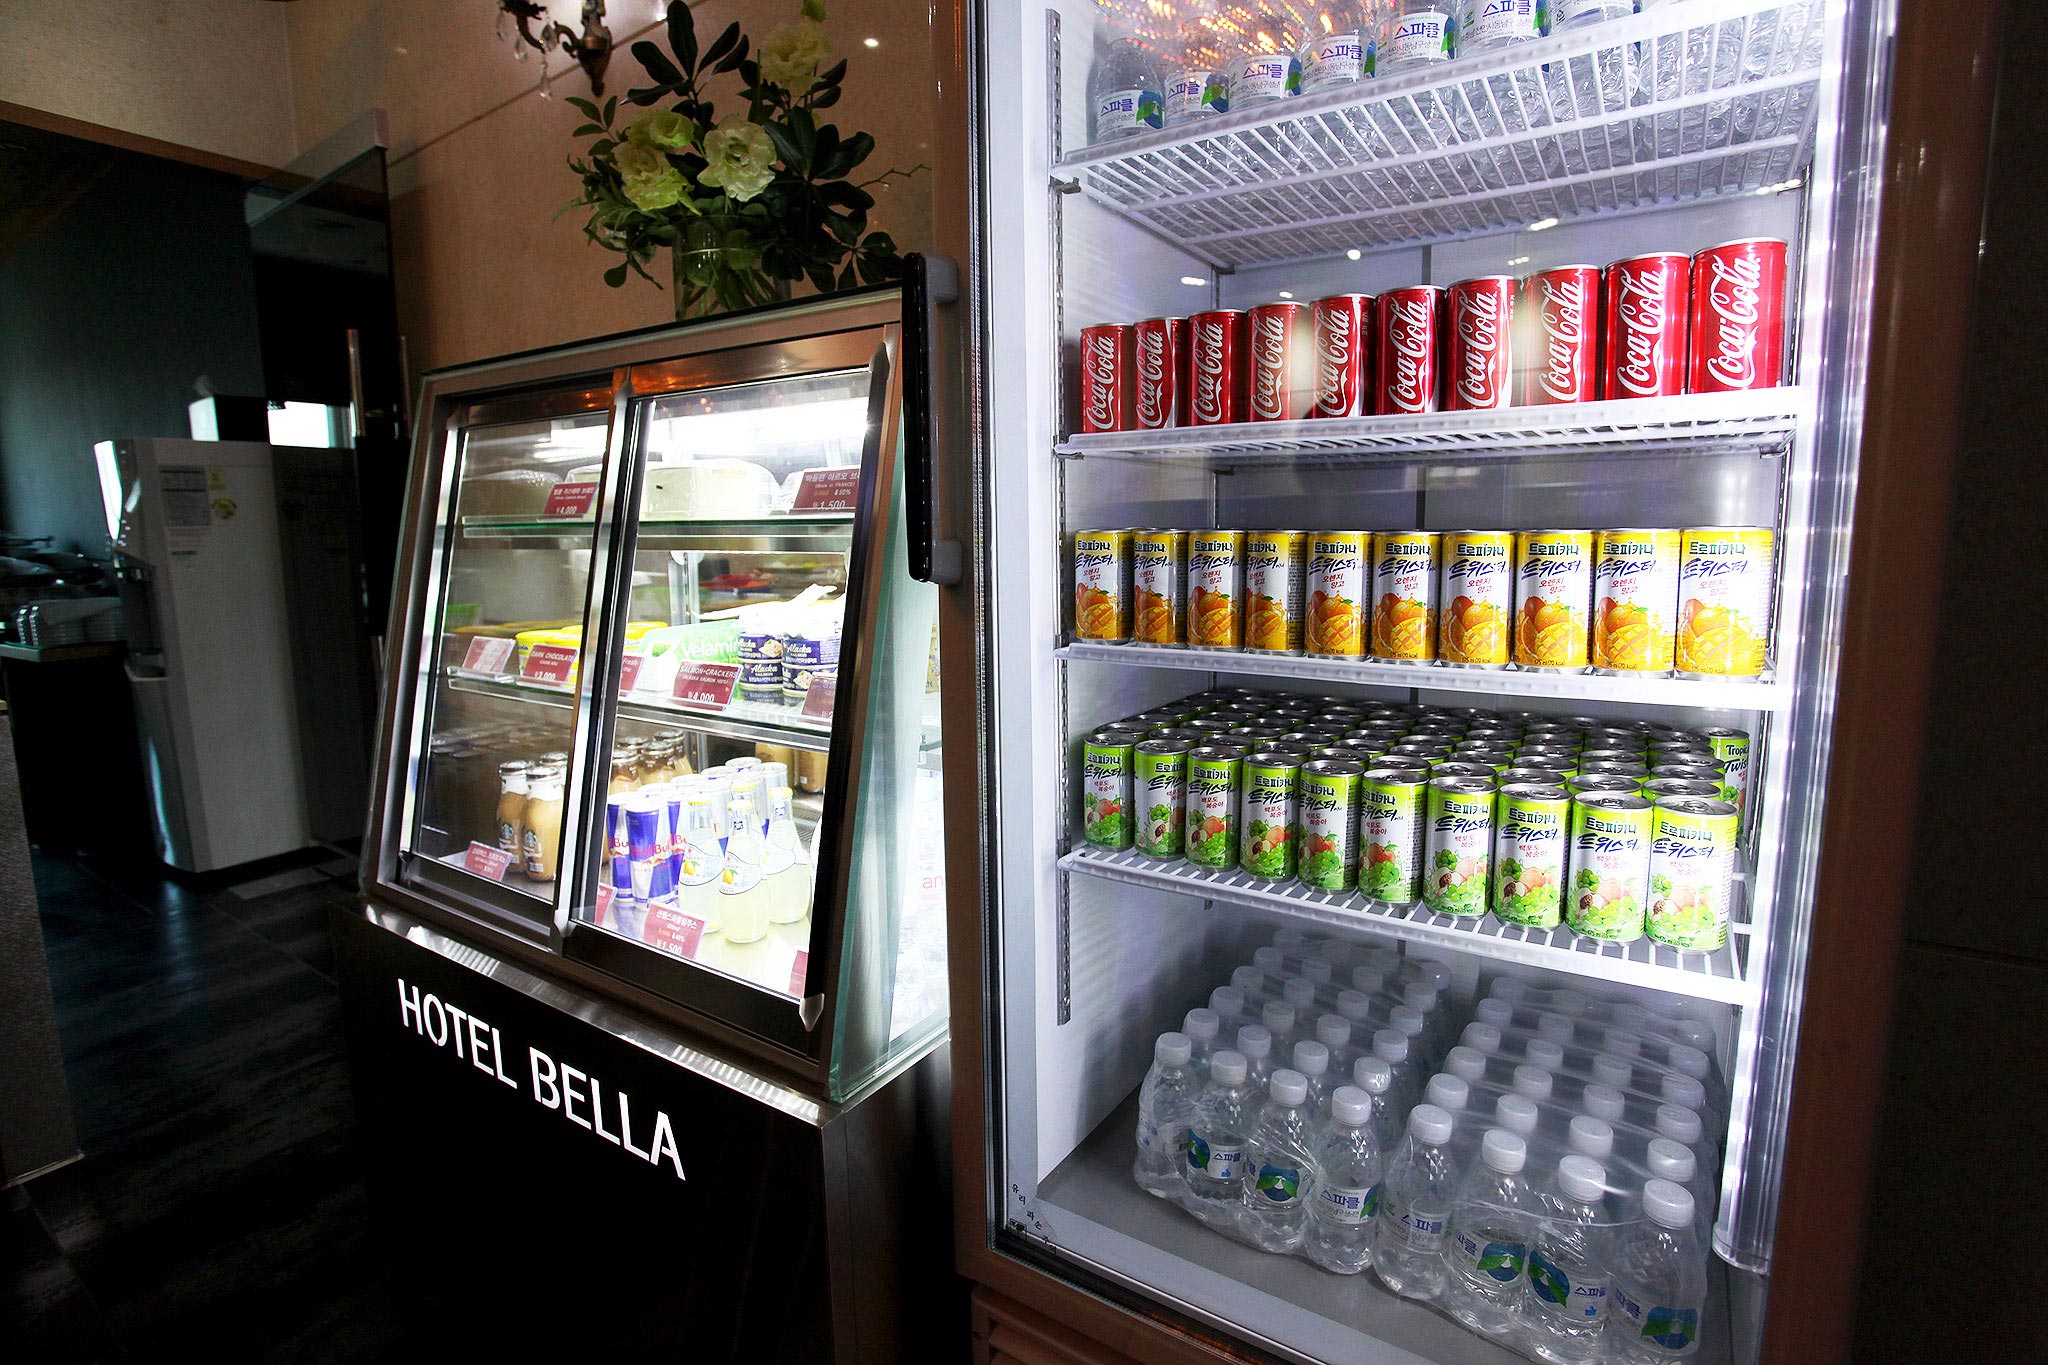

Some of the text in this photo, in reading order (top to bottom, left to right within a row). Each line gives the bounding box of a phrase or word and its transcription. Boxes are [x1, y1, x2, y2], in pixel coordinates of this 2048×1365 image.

[1482, 0, 1532, 18] 스파클
[1394, 22, 1440, 39] 스파클
[1321, 44, 1364, 60] 스파클
[1243, 63, 1284, 79] 스파클
[1168, 81, 1200, 99] 스파클
[1100, 98, 1134, 116] 스파클
[1078, 540, 1110, 550] 트로피카나
[1194, 541, 1232, 552] 트로피카나
[1314, 542, 1356, 554] 트로피카나
[1385, 542, 1431, 555] 트로피카나
[1457, 544, 1504, 556] 트로피카나
[1529, 542, 1579, 556] 트로피카나
[1602, 541, 1654, 555] 트로피카나
[1689, 541, 1746, 555] 트로피카나
[1076, 552, 1112, 568] 트위스터
[1190, 554, 1234, 572] 트위스터
[1309, 556, 1358, 575] 트위스터
[1378, 557, 1432, 577] 트위스터
[1202, 570, 1220, 578] 오렌지
[1250, 571, 1264, 580] 오렌지
[1449, 559, 1506, 580] 트위스터
[1521, 558, 1581, 580] 트위스터
[1597, 558, 1656, 580] 트위스터
[1682, 558, 1748, 580] 트위스터
[1322, 574, 1344, 582] 오렌지
[1394, 576, 1417, 585] 오렌지
[1467, 578, 1490, 587] 오렌지
[1539, 578, 1564, 588] 오렌지
[1611, 578, 1636, 588] 오렌지
[1700, 579, 1726, 589] 오렌지
[1478, 586, 1492, 594] 망고
[1550, 586, 1565, 594] 망고
[1622, 586, 1637, 595] 망고
[1710, 588, 1728, 597] 망고
[787, 644, 812, 654] Alaska
[751, 664, 778, 673] Alaska
[1088, 752, 1120, 764] 트로피카나
[1084, 764, 1122, 779] 트위스터
[1194, 766, 1230, 779] 트로피카나
[1188, 780, 1232, 795] 트위스터
[1254, 775, 1294, 787] 트로피카나
[1248, 788, 1296, 804] 트위스터
[1509, 808, 1557, 824] 트로피카나
[1435, 816, 1490, 832] 트위스터
[1585, 817, 1638, 834] 트로피카나
[1660, 821, 1713, 842] 트로피카나
[1501, 824, 1558, 842] 트위스터
[1577, 833, 1638, 852] 트위스터
[1653, 838, 1714, 858] 트위스터
[398, 978, 686, 1180] HOTEL BELLA
[1214, 1152, 1241, 1162] 스파클
[1321, 1190, 1360, 1209] 스파클
[1401, 1214, 1442, 1234] 스파클
[1456, 1228, 1477, 1256] 파클
[1616, 1288, 1641, 1319] 파클
